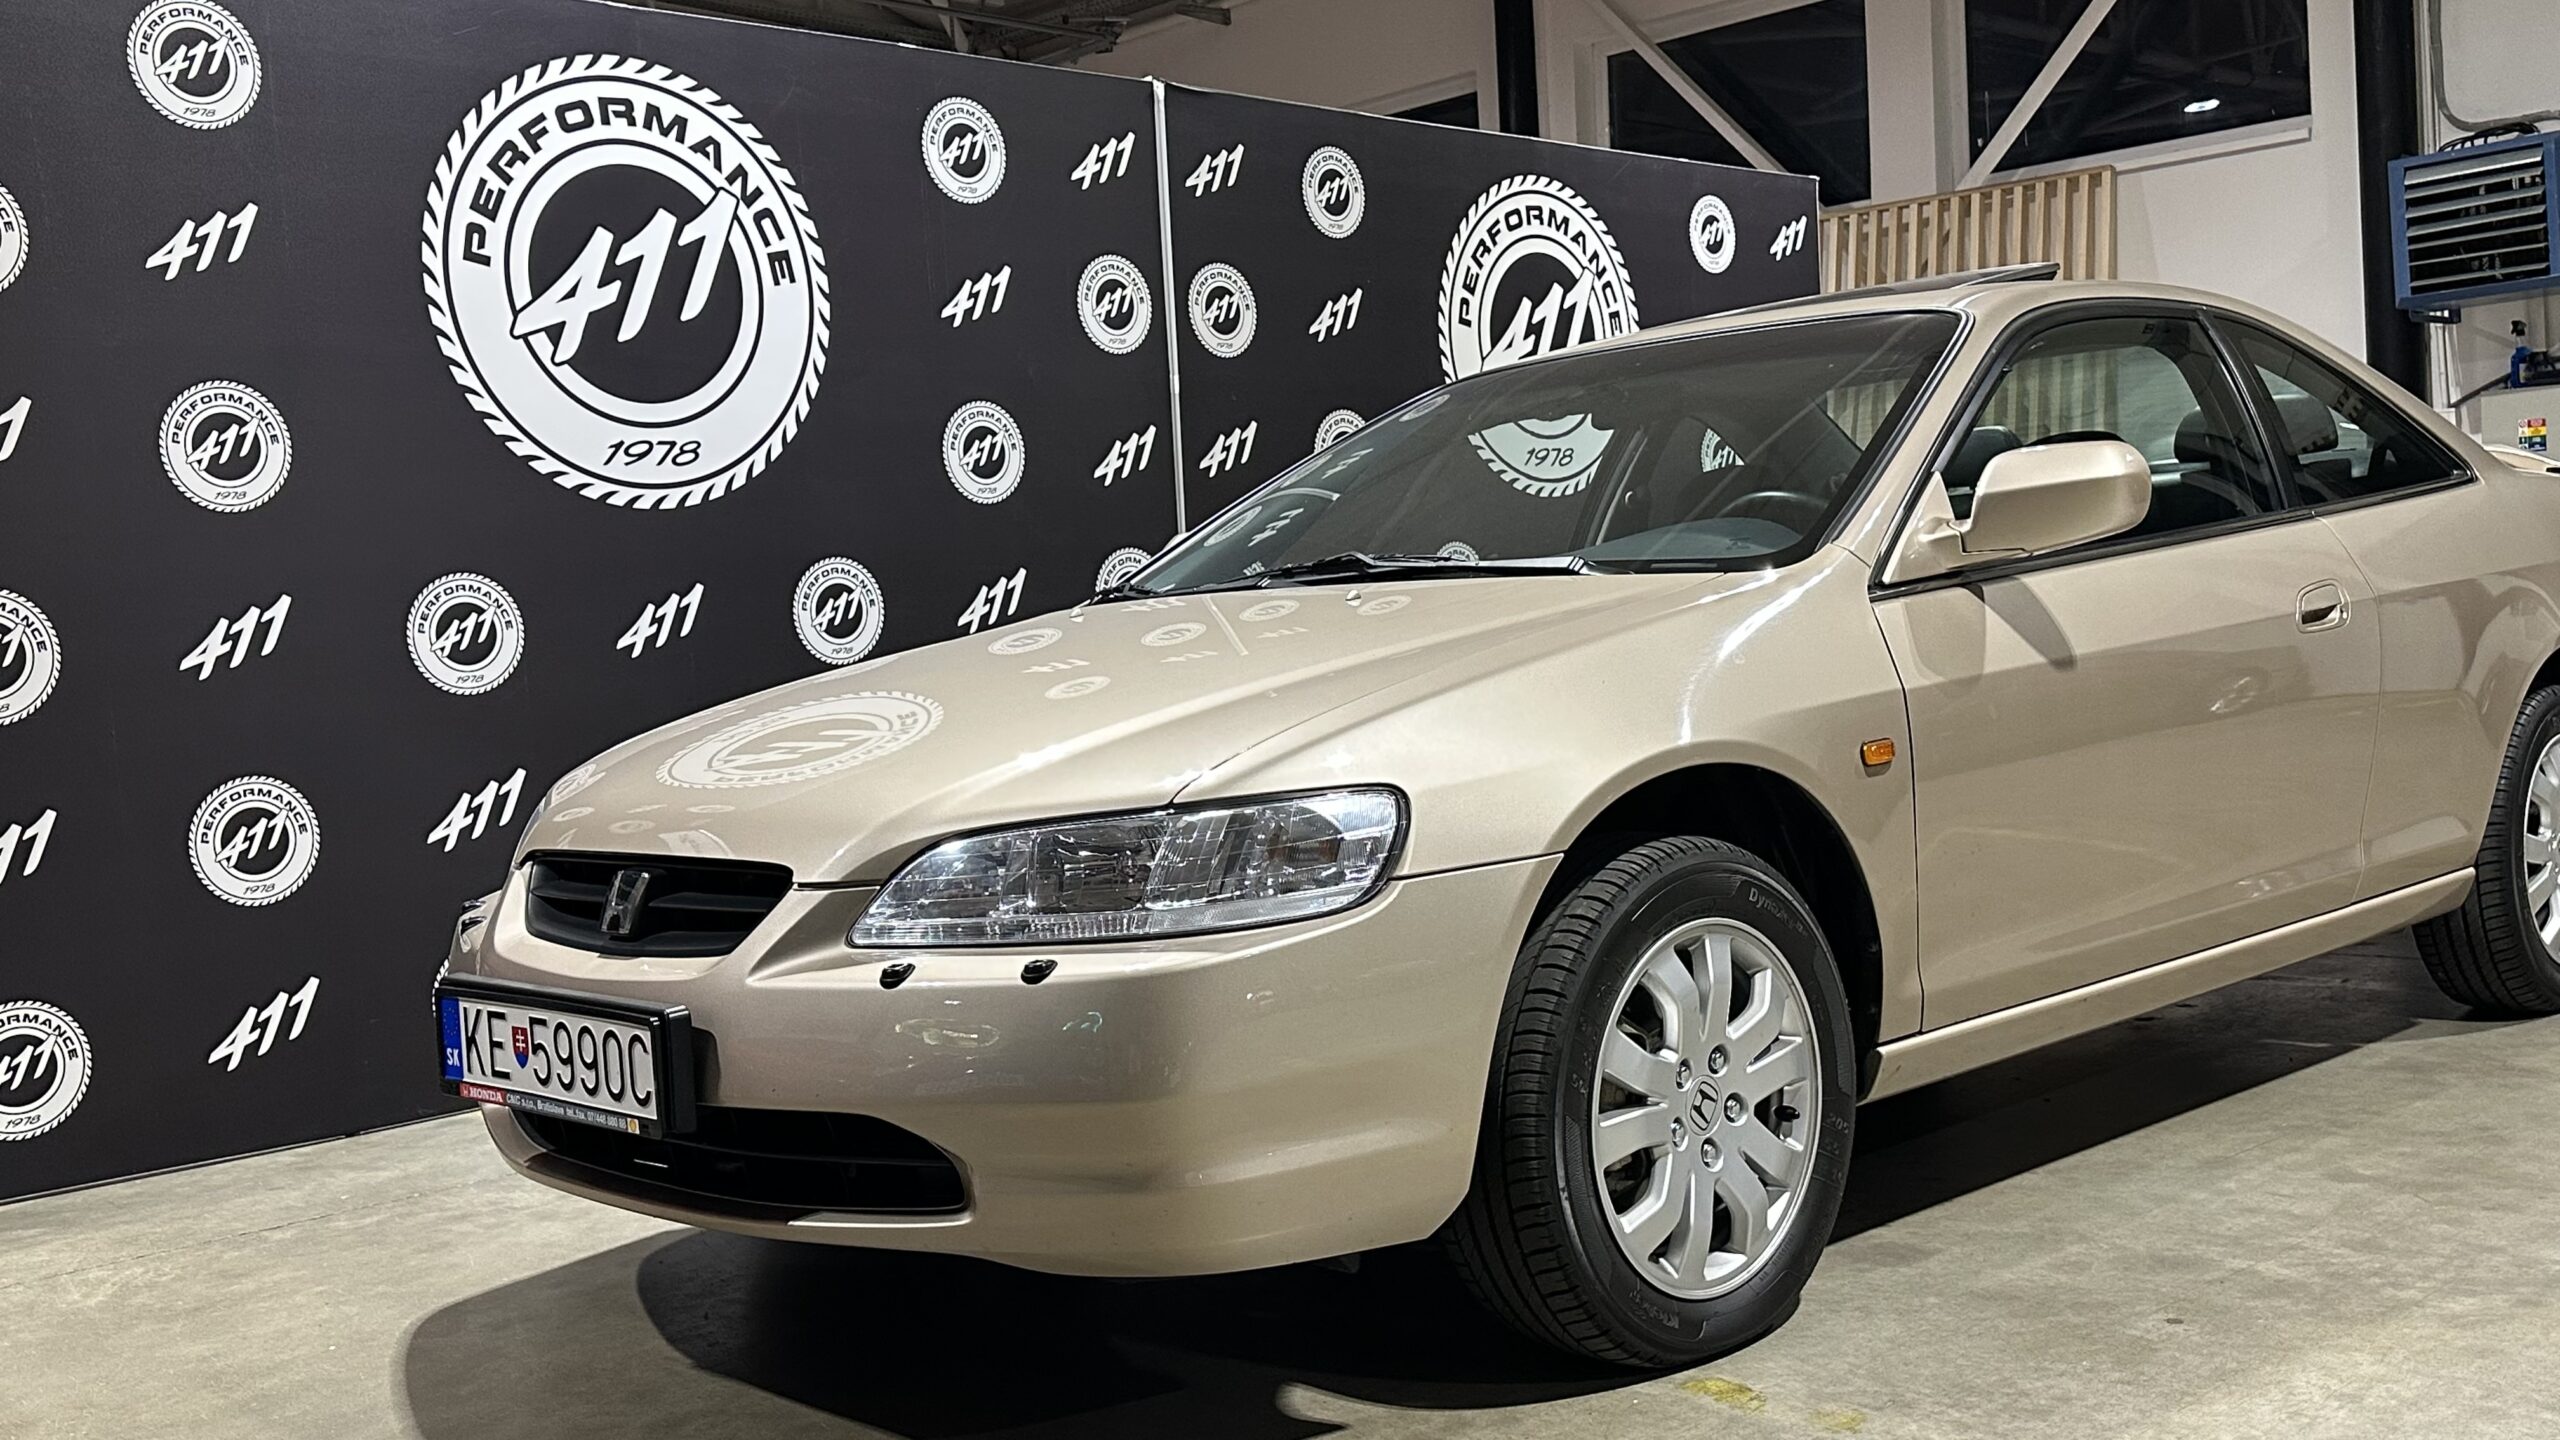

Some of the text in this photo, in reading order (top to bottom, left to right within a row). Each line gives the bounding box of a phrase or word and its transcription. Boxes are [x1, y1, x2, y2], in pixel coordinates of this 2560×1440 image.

[139, 7, 249, 67] PERFORMANCE
[154, 35, 230, 84] 411
[183, 106, 216, 118] 1978
[930, 107, 998, 152] PERFORMANCE
[939, 129, 986, 168] 411
[1071, 132, 1135, 191] 411
[1185, 144, 1244, 198] 411
[462, 97, 797, 288] PERFORMANCE
[1308, 155, 1359, 193] PERFORMANCE
[1316, 172, 1351, 209] 411
[145, 203, 258, 280] 411
[1770, 216, 1807, 261] 411
[513, 188, 740, 366] 411
[1084, 264, 1145, 305] PERFORMANCE
[1194, 271, 1250, 312] PERFORMANCE
[1459, 205, 1623, 336] PERFORMANCE
[941, 266, 1011, 327] 411
[1093, 283, 1135, 322] 411
[1202, 291, 1241, 327] 411
[1309, 288, 1362, 342] 411
[1482, 266, 1595, 360] 411
[171, 393, 280, 445] PERFORMANCE
[185, 416, 260, 471] 411
[951, 410, 1017, 451] PERFORMANCE
[604, 440, 702, 468] 1978
[960, 429, 1006, 472] 411
[1094, 425, 1156, 486] 411
[1200, 421, 1257, 477] 411
[1524, 447, 1574, 467] 1978
[213, 491, 247, 501] 1978
[418, 584, 514, 633] PERFORMANCE
[801, 567, 876, 611] PERFORMANCE
[812, 585, 863, 631] 411
[958, 568, 1026, 634] 411
[180, 595, 291, 680] 411
[430, 604, 497, 658] 411
[617, 583, 704, 658] 411
[455, 674, 484, 684] 1978
[200, 788, 308, 844] PERFORMANCE
[427, 768, 526, 852] 411
[0, 809, 56, 884] 11
[215, 808, 288, 868] 411
[243, 882, 275, 895] 1978
[208, 977, 319, 1071] 411
[463, 1006, 511, 1081] KE
[446, 1047, 460, 1067] SK
[469, 1087, 502, 1103] HONDA
[5, 1115, 41, 1130] 1978
